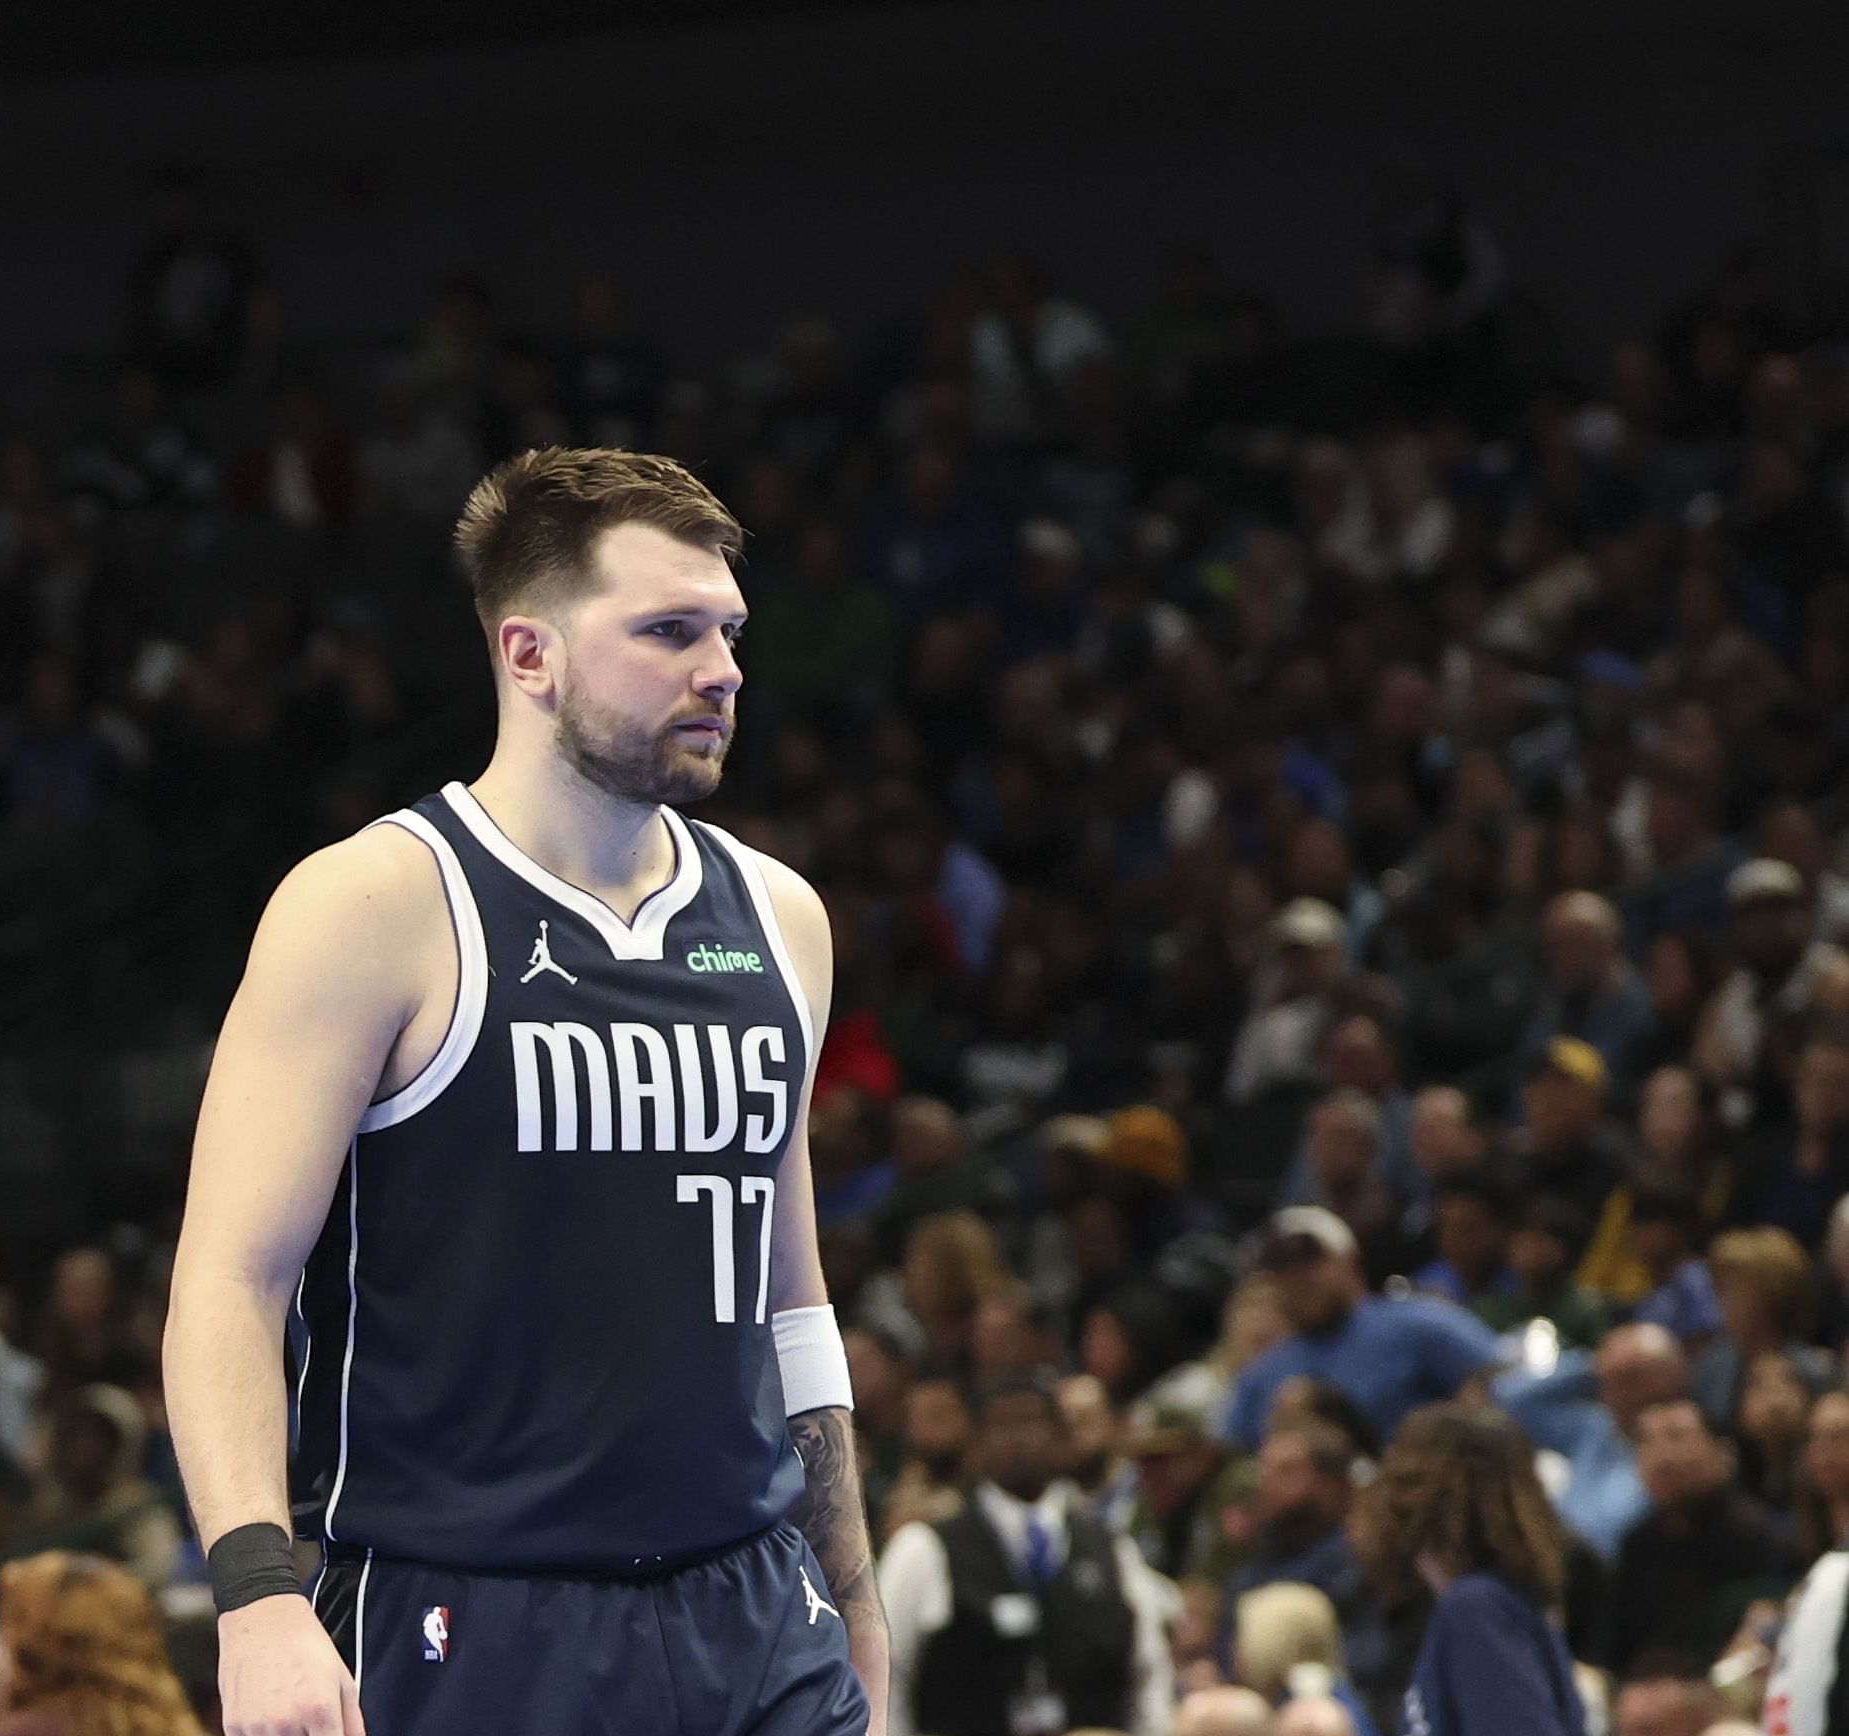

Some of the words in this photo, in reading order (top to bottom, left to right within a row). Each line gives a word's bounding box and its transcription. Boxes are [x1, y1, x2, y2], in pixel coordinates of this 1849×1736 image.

[686, 943, 765, 973] chime
[509, 1021, 788, 1154] MAVS
[676, 1174, 776, 1325] 77
